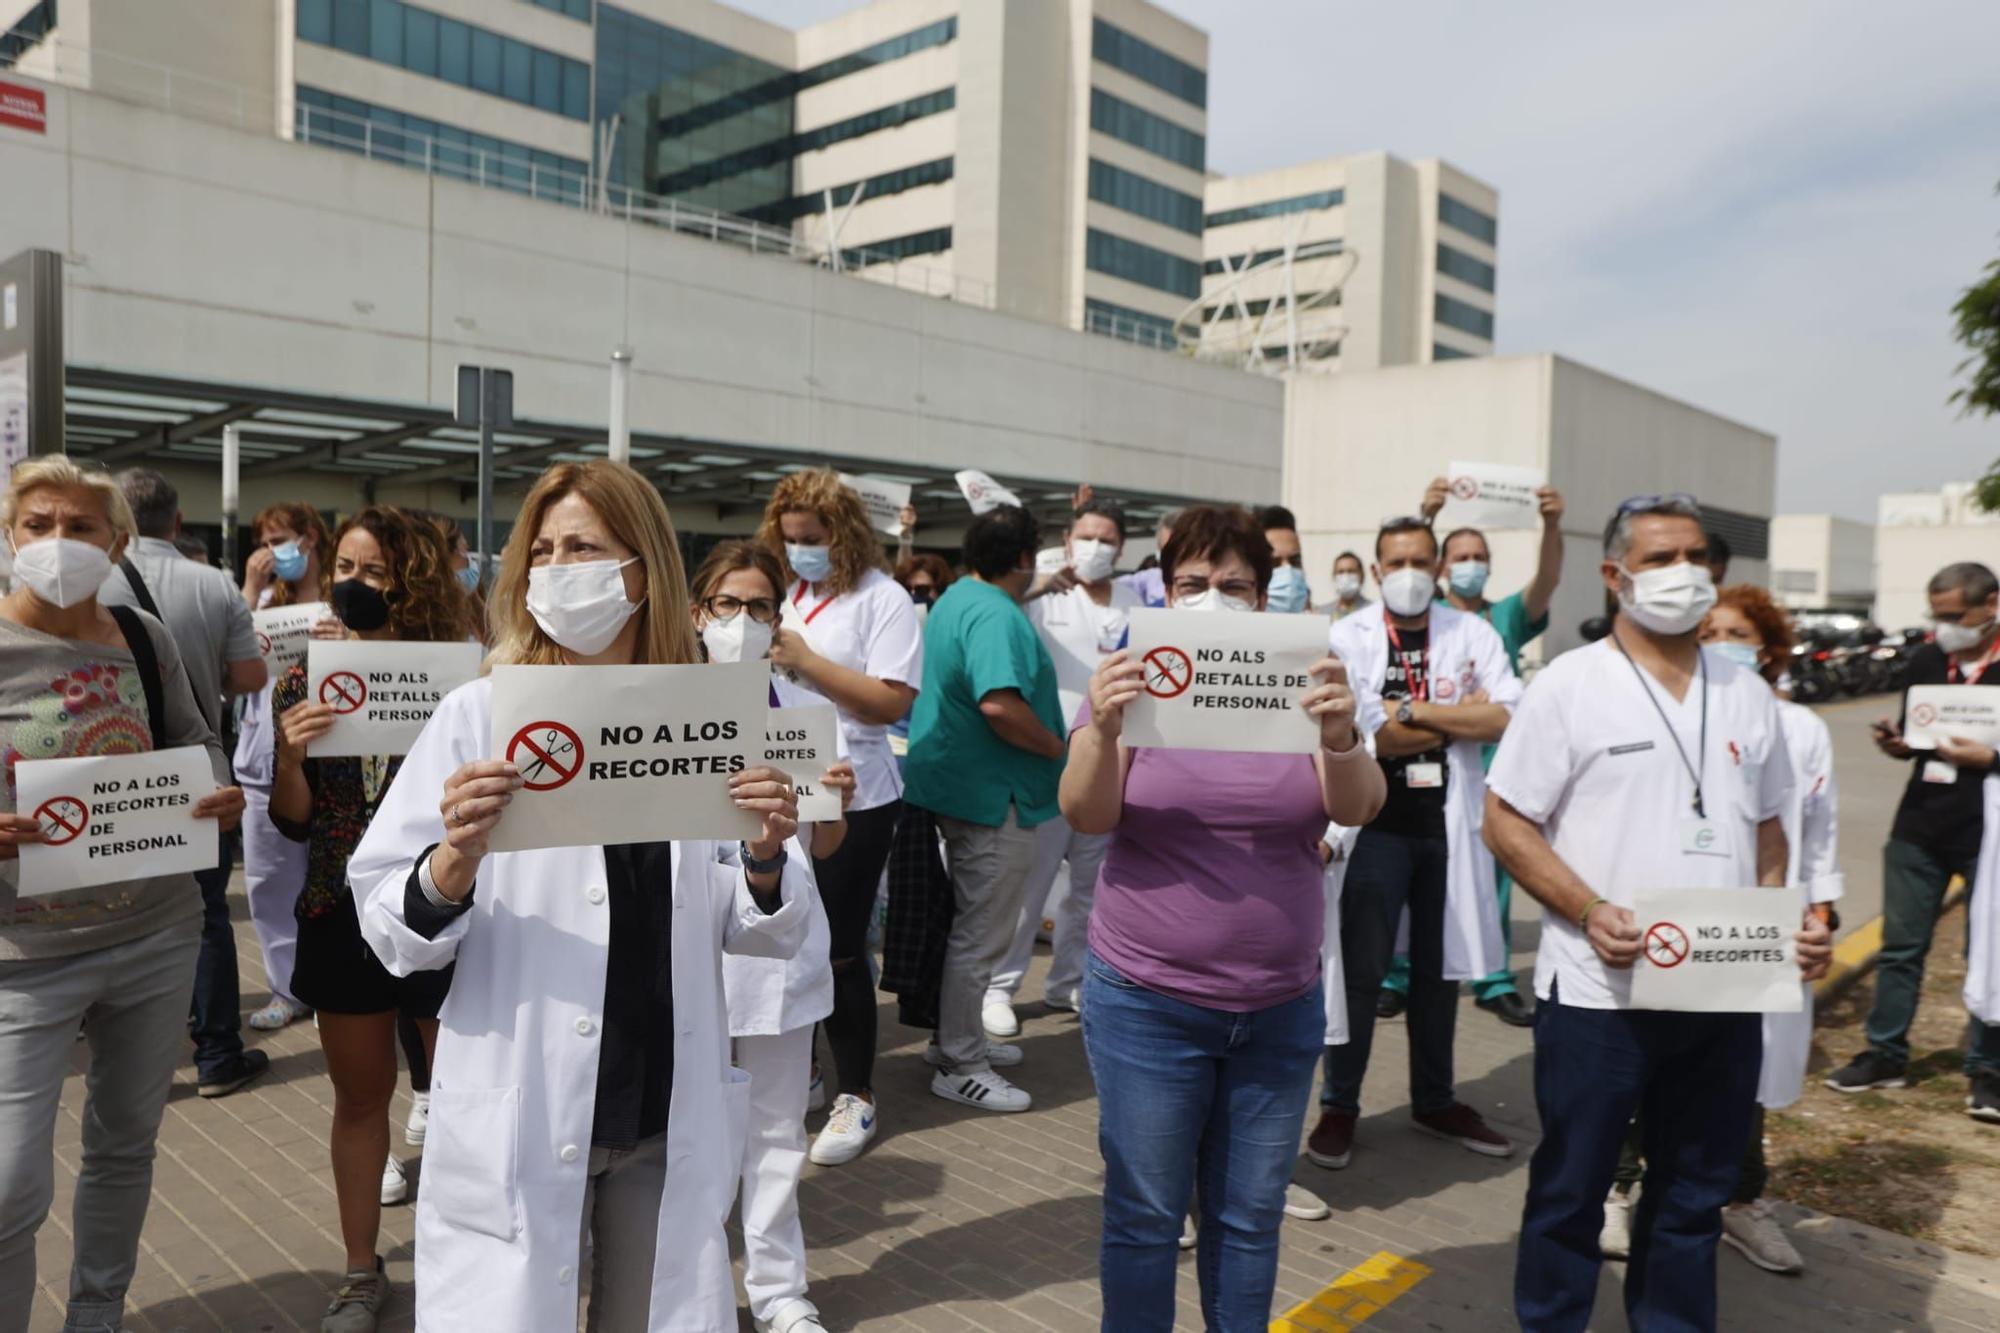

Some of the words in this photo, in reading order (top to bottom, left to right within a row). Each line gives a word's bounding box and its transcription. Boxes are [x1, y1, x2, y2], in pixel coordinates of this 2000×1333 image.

[1197, 649, 1223, 662] NO
[1230, 650, 1265, 664] ALS
[369, 672, 392, 683] NO
[398, 672, 429, 683] ALS
[1195, 672, 1278, 687] RETALLS
[1284, 675, 1308, 688] DE
[368, 691, 441, 702] RETALLS
[1193, 695, 1292, 710] PERSONAL
[368, 710, 434, 720] PERSON
[600, 725, 644, 746] NO
[652, 725, 673, 743] A
[683, 721, 738, 742] LOS
[776, 730, 807, 741] LOS
[764, 748, 816, 760] ORTES
[589, 755, 745, 780] RECORTES
[93, 781, 120, 795] NO
[127, 781, 140, 791] A
[145, 774, 180, 789] LOS
[91, 793, 190, 816] RECORTES
[90, 822, 115, 837] DE
[88, 834, 188, 859] PERSONAL
[1697, 926, 1723, 939] NO
[1729, 926, 1740, 939] A
[1746, 926, 1780, 939] LOS
[1692, 949, 1784, 962] RECORTES
